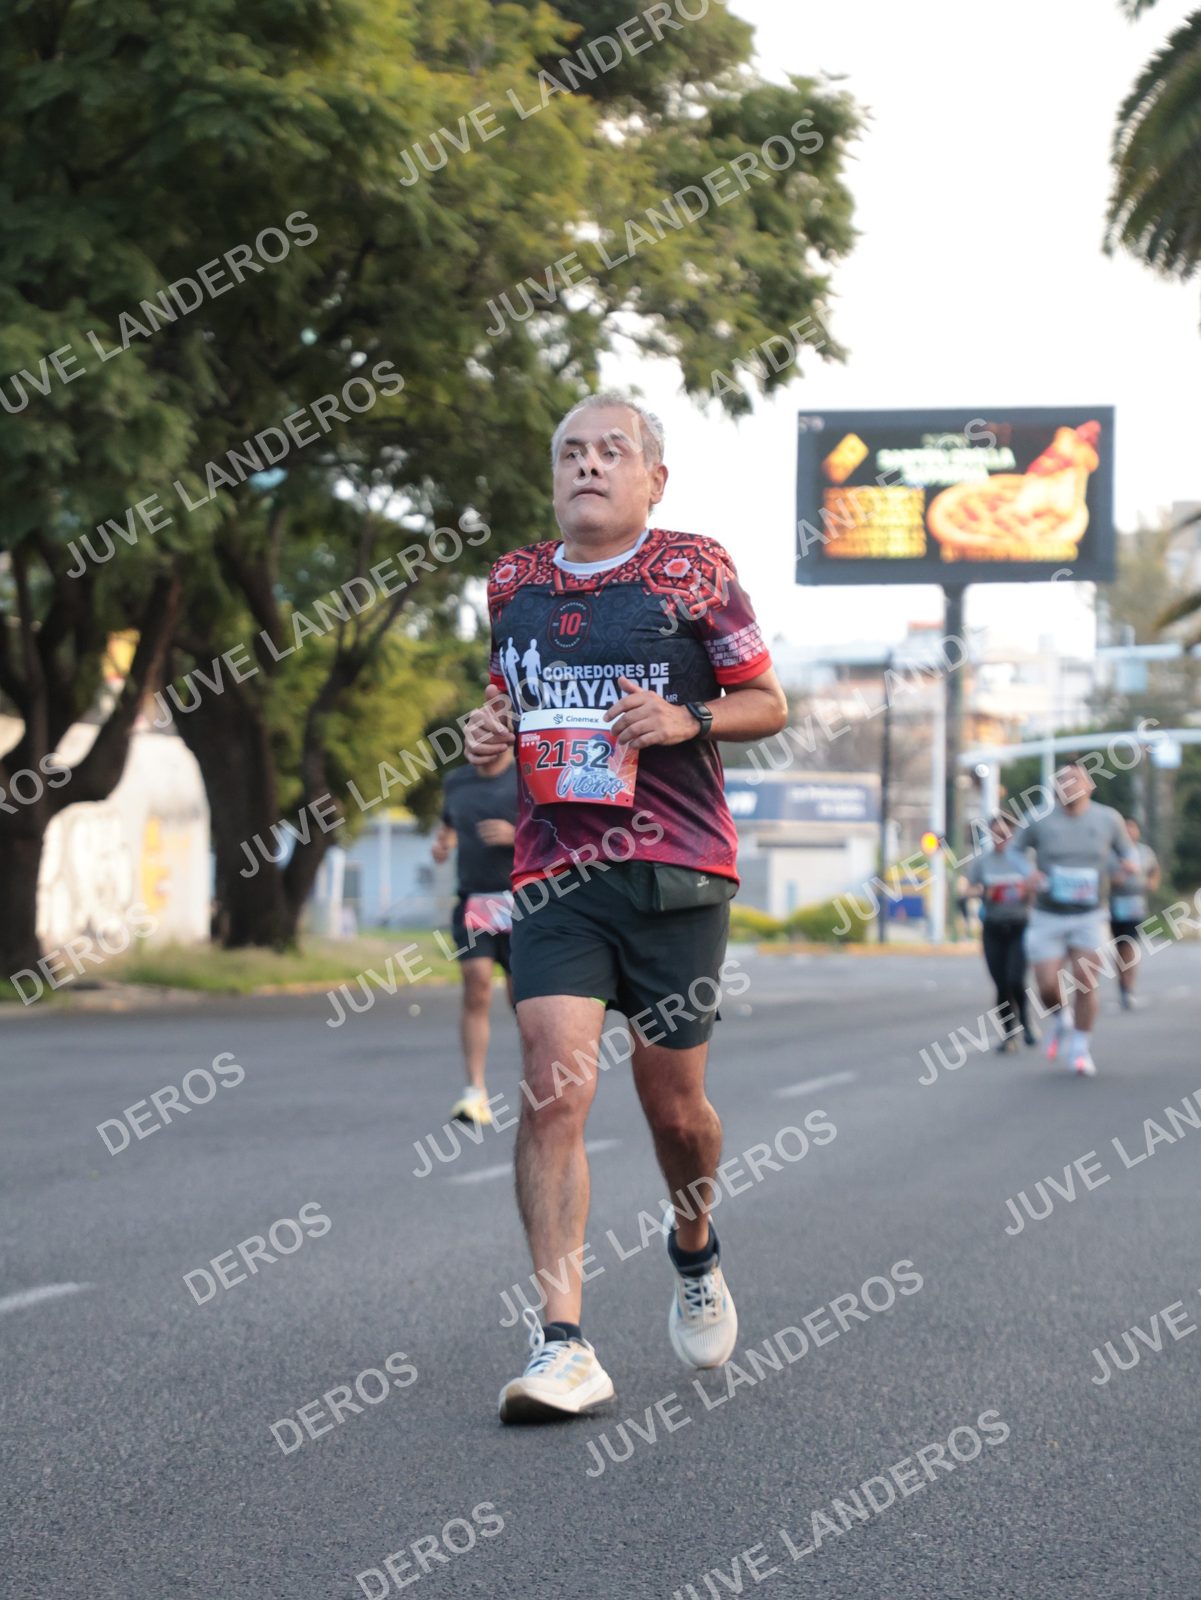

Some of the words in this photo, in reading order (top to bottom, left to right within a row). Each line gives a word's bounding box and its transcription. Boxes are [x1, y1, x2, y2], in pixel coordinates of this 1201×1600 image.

[559, 611, 582, 636] 10
[542, 663, 645, 681] CORREDORES
[649, 662, 670, 677] DE
[566, 715, 599, 723] Cinemex
[535, 739, 611, 770] 2152
